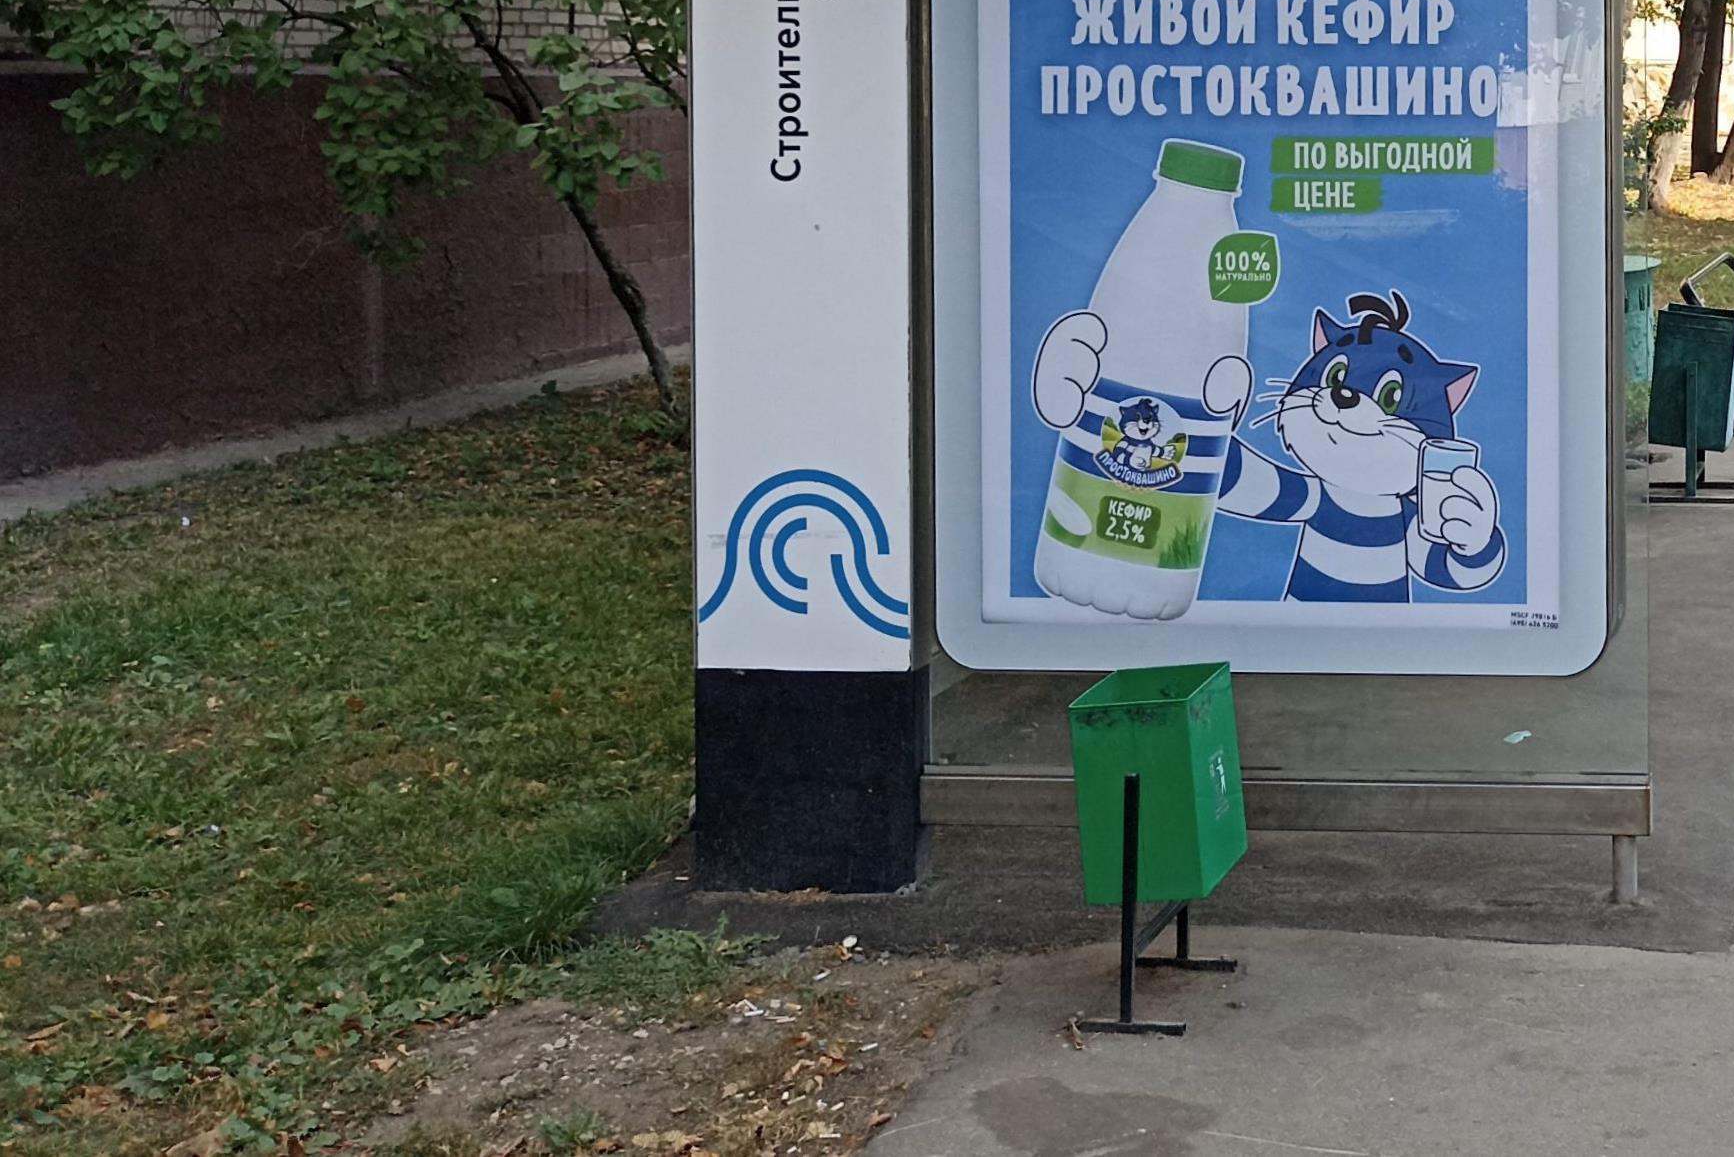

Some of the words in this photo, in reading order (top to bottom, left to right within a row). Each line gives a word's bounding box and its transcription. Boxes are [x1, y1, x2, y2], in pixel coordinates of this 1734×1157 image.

[1041, 64, 1499, 117] ПРОСТОКВАШИНО
[1294, 141, 1327, 170] ПО
[1335, 137, 1473, 173] ВЫГОДНОЙ
[1294, 180, 1356, 211] ЦЕНЕ
[1215, 250, 1271, 272] 100%
[1215, 272, 1272, 282] НАТУРАЛЬНО
[1098, 451, 1177, 485] ПРОСТОКВАШИНО
[1108, 499, 1153, 522] КЕФИР
[1105, 516, 1146, 544] 2,5%
